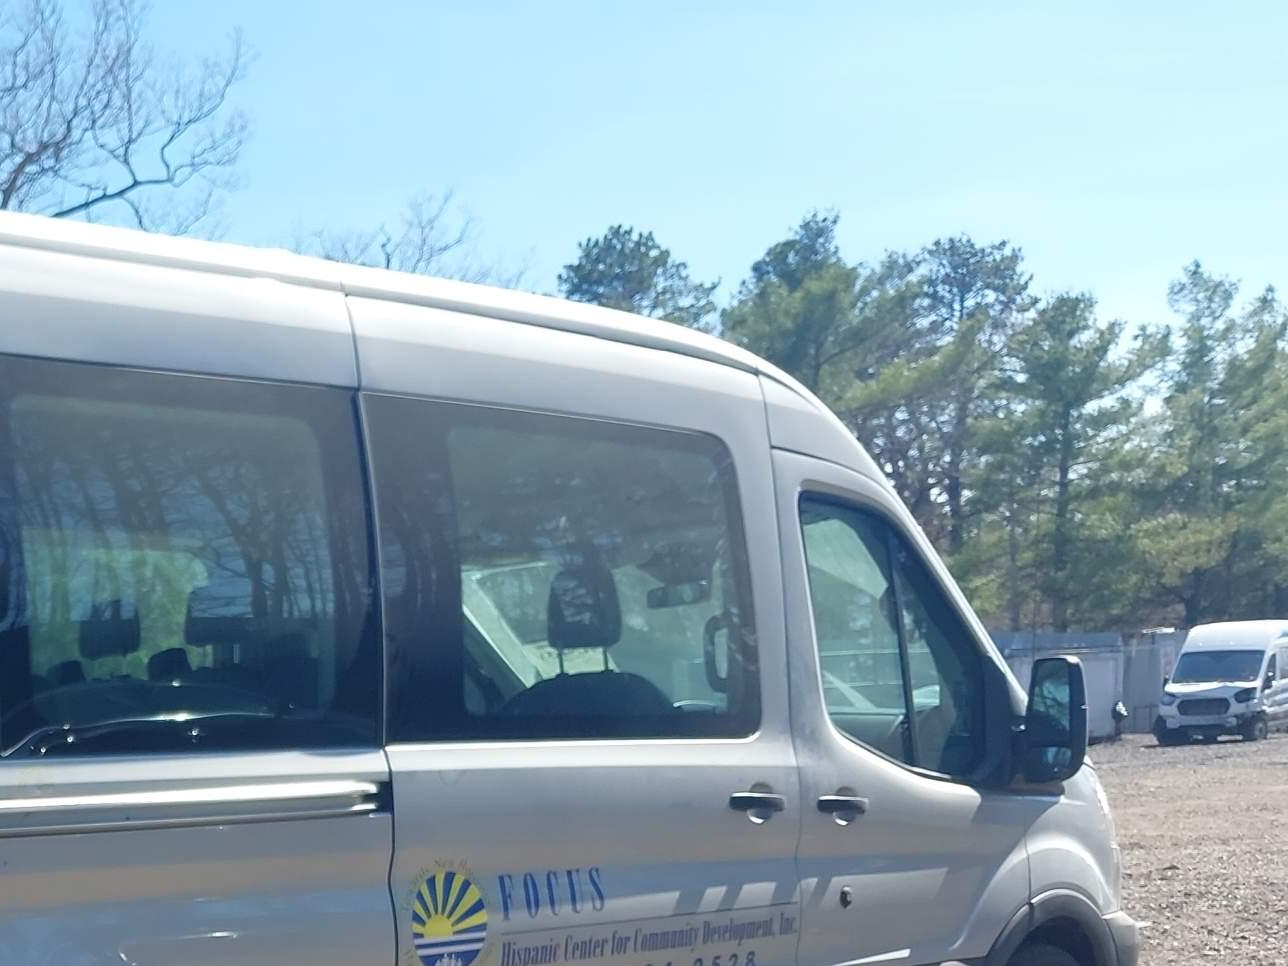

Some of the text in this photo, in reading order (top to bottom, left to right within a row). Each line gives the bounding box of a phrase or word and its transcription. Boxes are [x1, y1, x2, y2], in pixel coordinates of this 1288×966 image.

[498, 867, 605, 921] FOCUS
[564, 935, 608, 962] Center
[611, 929, 631, 957] for
[633, 925, 699, 953] Community
[779, 912, 799, 936] Inc.
